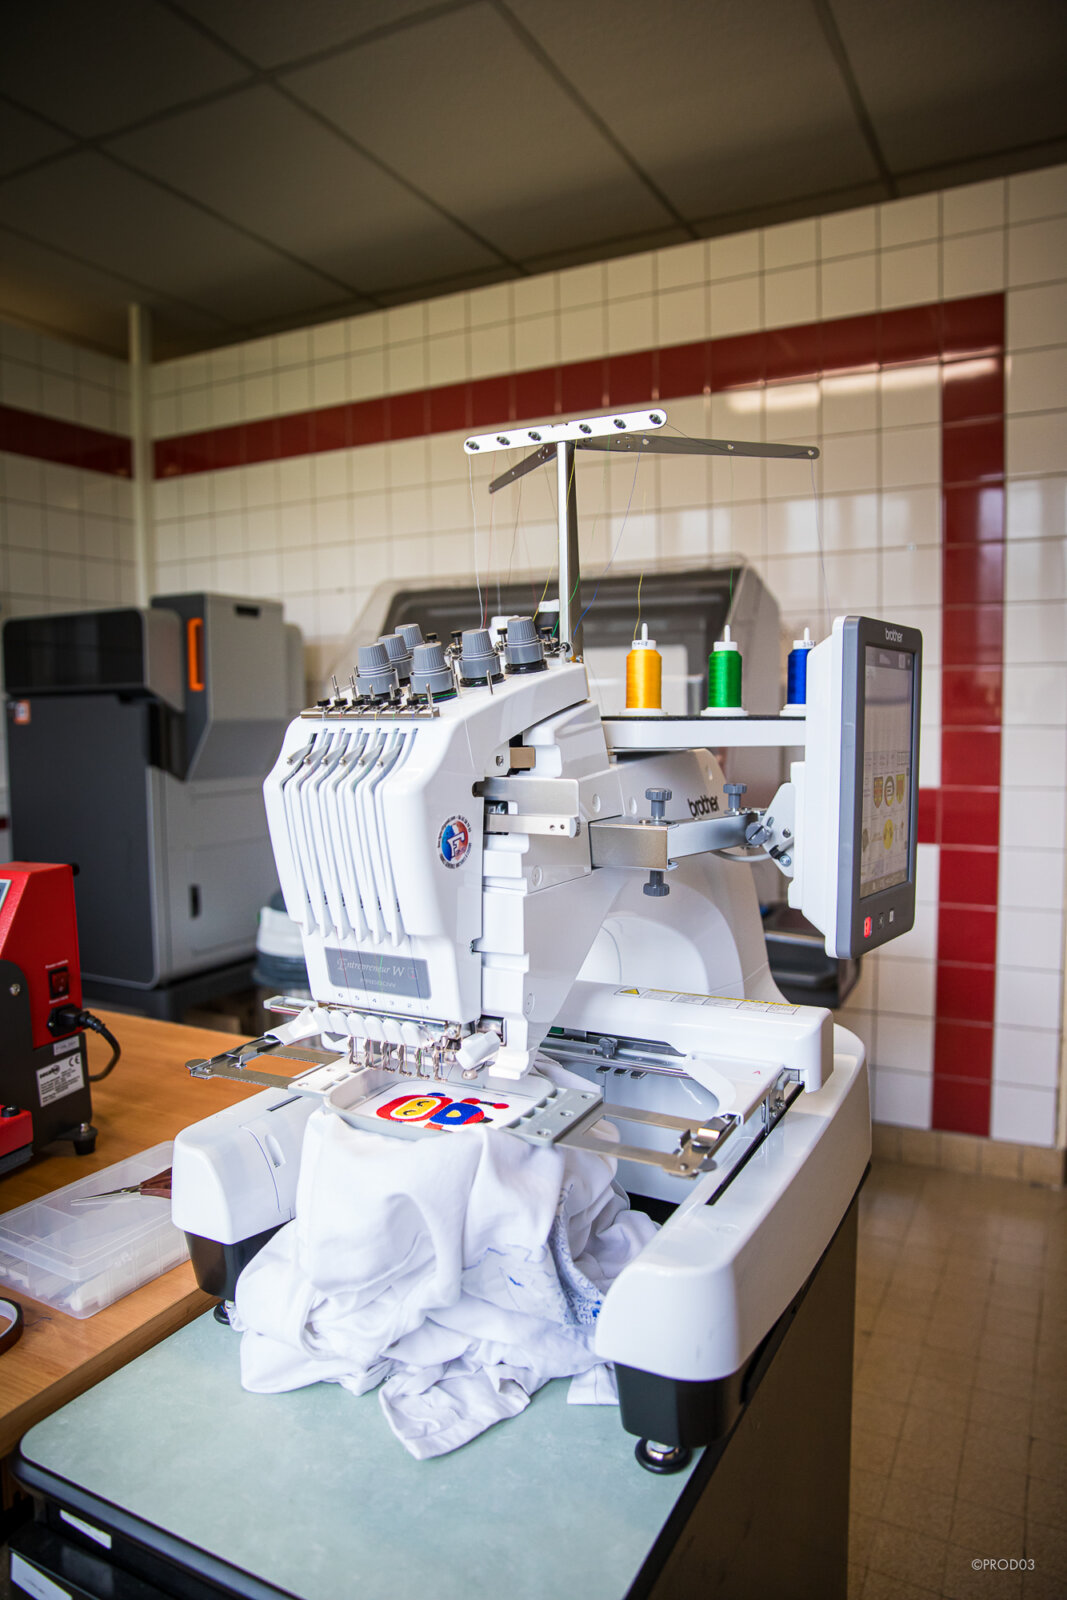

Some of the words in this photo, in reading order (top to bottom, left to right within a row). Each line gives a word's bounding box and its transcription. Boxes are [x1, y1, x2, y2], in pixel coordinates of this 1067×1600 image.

[885, 627, 903, 643] brother
[687, 794, 720, 817] brother
[393, 965, 405, 977] W
